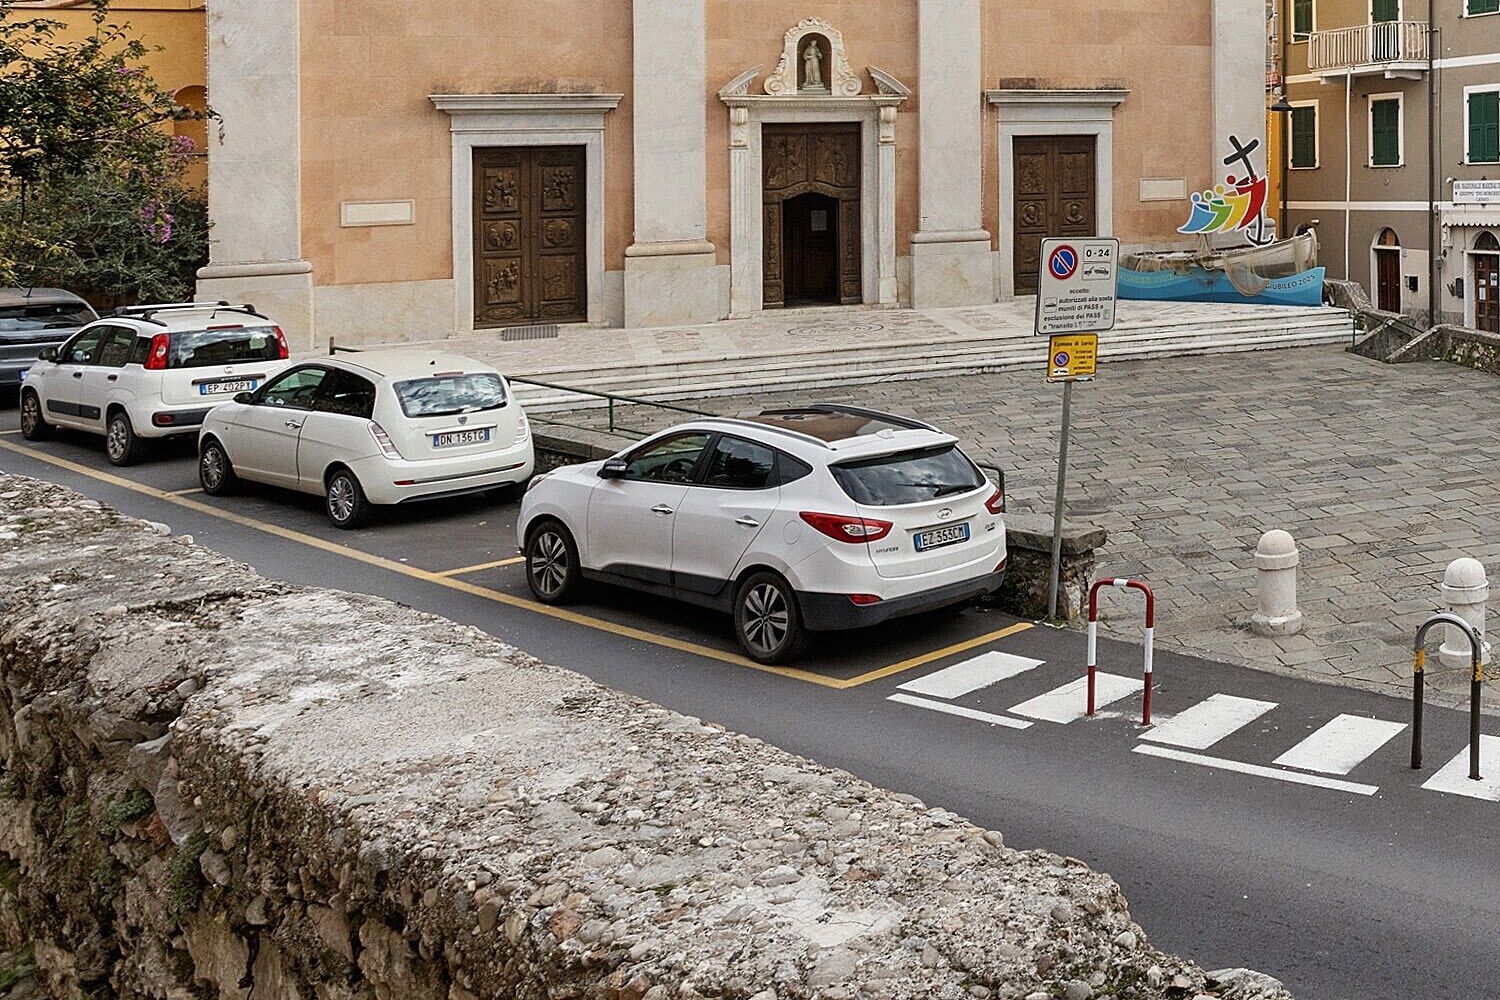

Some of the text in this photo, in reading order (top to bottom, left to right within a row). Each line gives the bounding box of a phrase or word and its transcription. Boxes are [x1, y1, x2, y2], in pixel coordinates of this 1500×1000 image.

[1086, 249, 1092, 257] 0
[1098, 249, 1110, 257] 24
[1299, 274, 1316, 286] 2025
[208, 384, 219, 393] EP
[440, 435, 452, 446] DN
[922, 533, 934, 546] EZ
